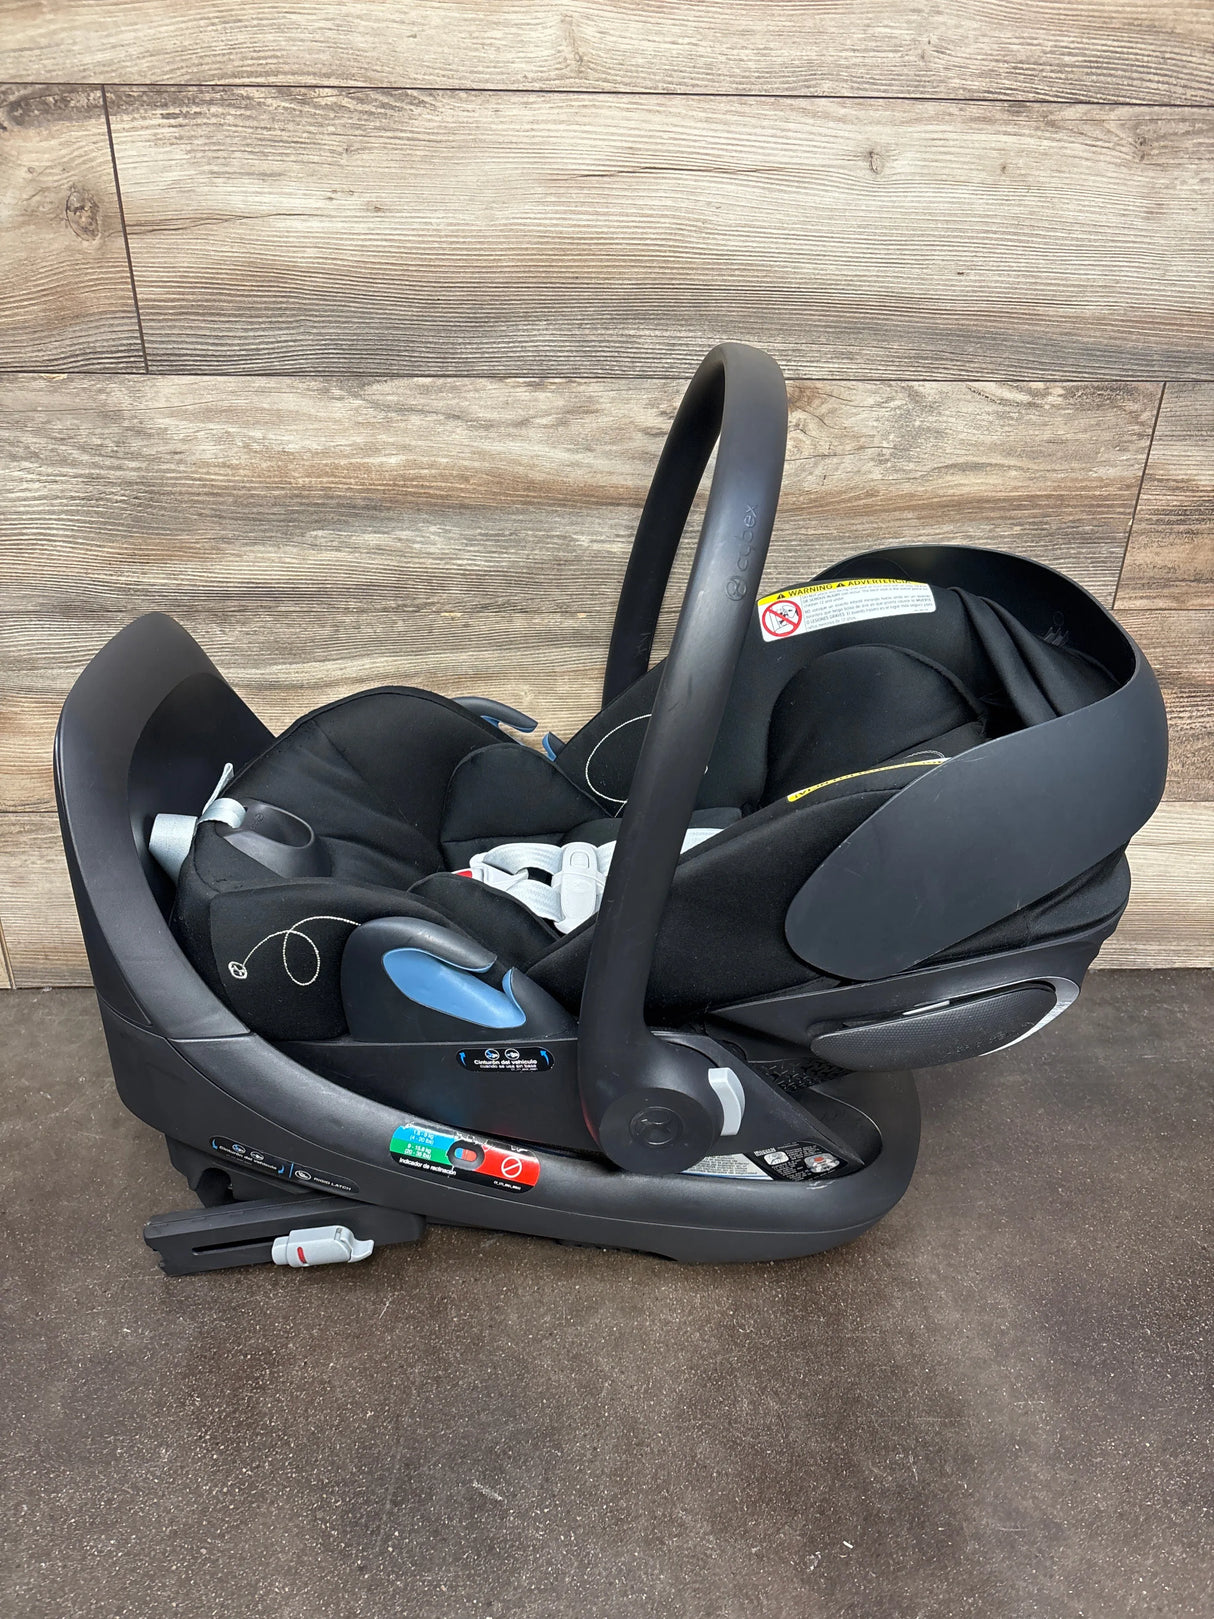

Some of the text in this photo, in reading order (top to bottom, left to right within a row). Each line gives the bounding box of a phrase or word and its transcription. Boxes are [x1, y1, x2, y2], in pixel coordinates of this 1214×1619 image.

[788, 583, 833, 597] WARNING
[399, 1157, 423, 1168] Indicador
[330, 1181, 352, 1191] LATCH
